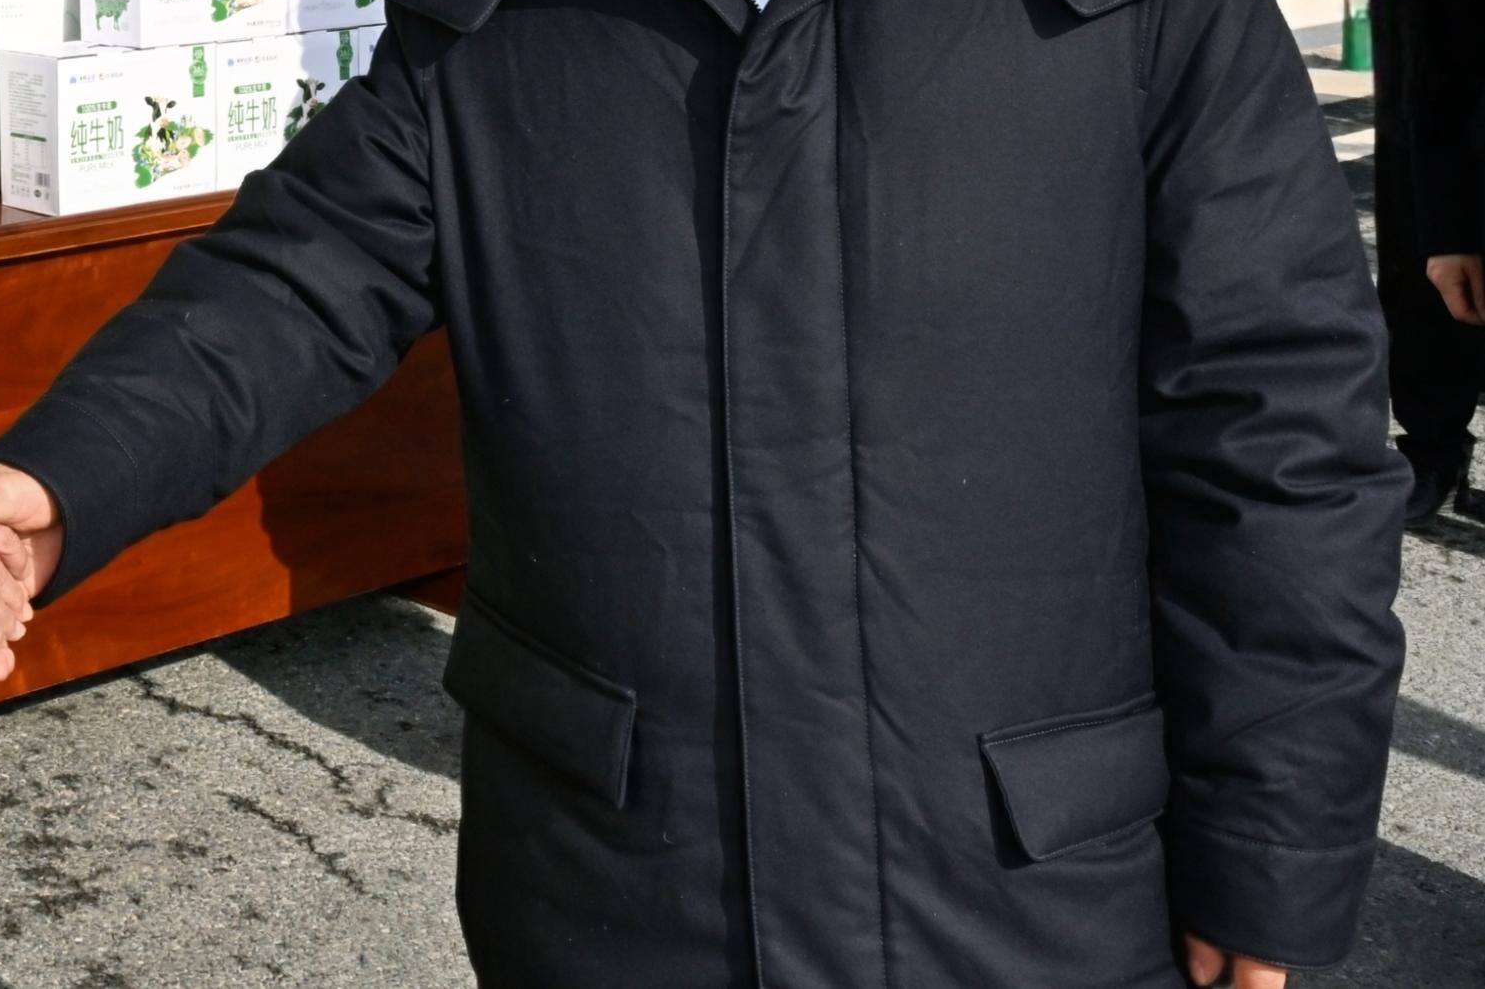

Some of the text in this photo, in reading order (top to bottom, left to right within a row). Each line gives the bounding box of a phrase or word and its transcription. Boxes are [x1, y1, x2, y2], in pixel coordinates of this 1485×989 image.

[70, 115, 124, 156] 纯牛奶
[228, 96, 277, 135] 纯牛奶
